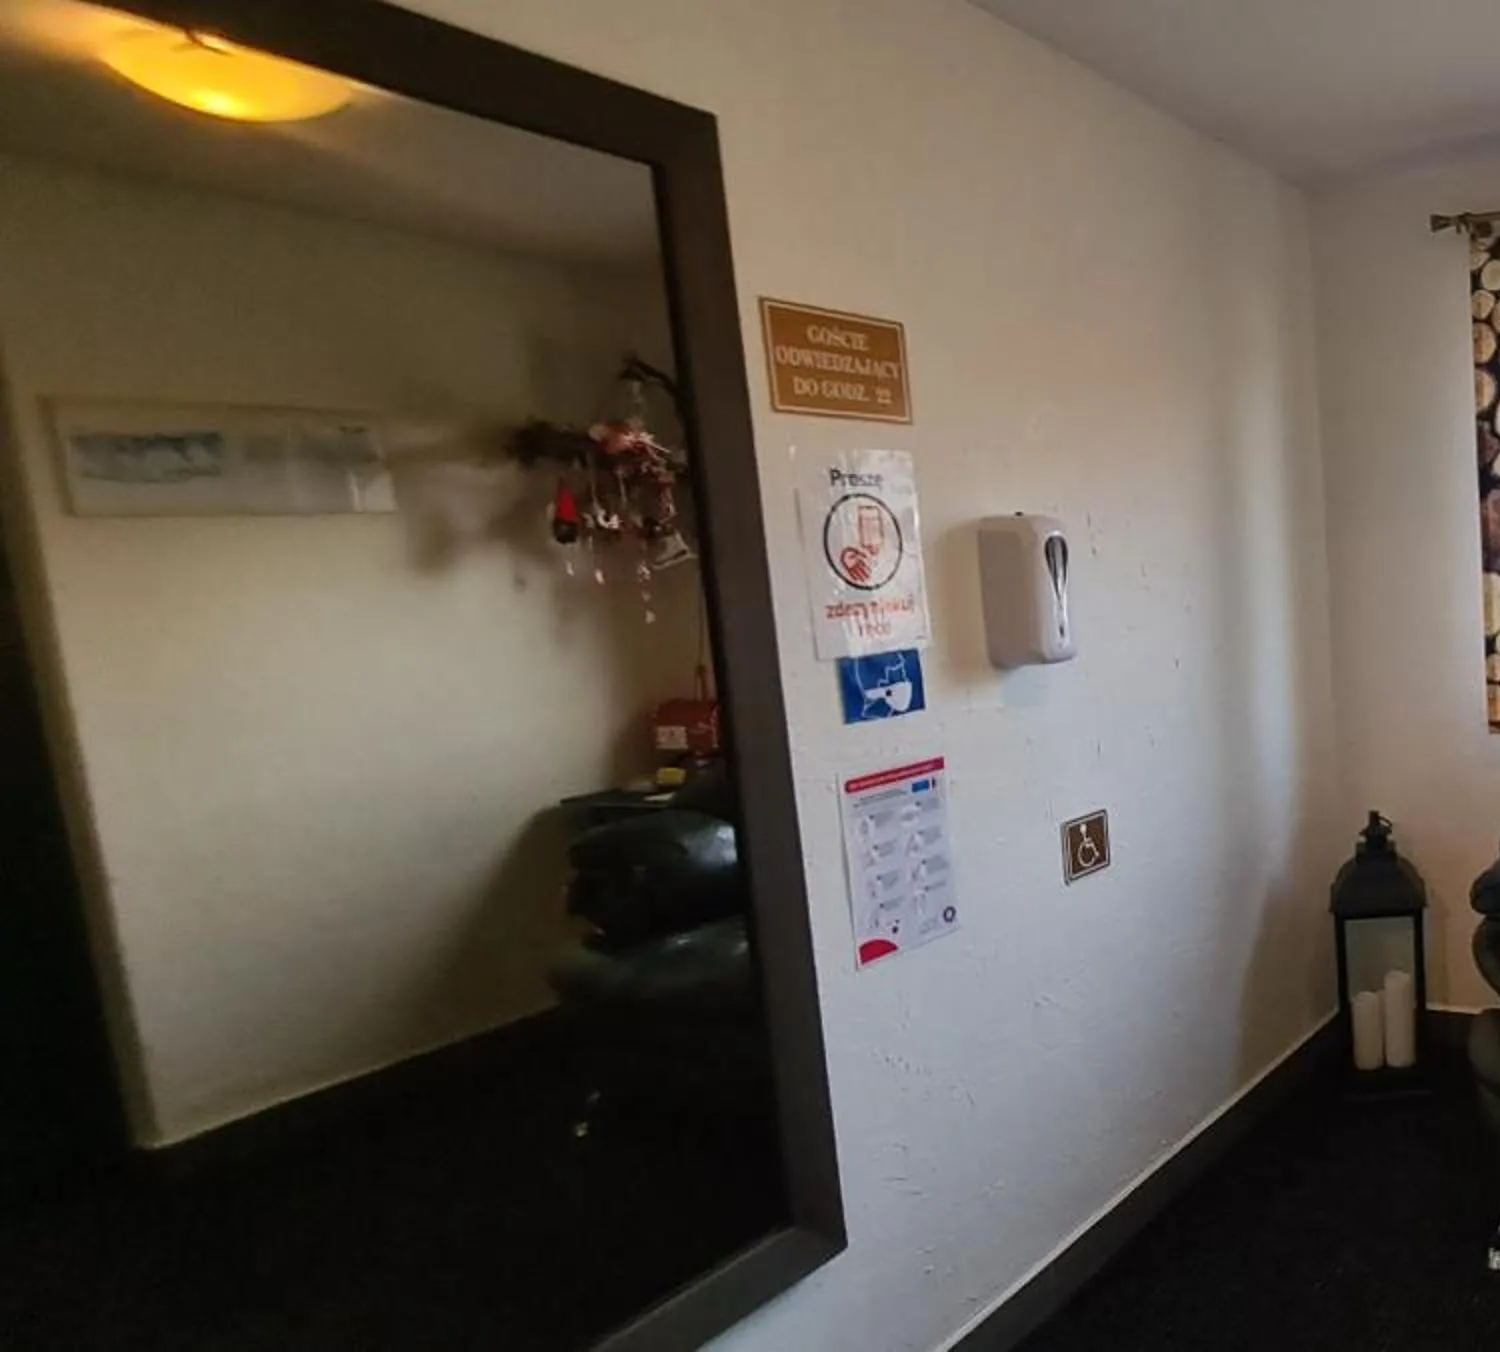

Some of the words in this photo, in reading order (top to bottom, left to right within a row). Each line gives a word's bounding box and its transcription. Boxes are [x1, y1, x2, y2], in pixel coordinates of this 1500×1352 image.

[807, 325, 869, 351] GOŚCIE
[776, 345, 899, 379] ODWIEDZAJĄCY
[792, 376, 819, 397] DO
[821, 380, 870, 403] GODZ.
